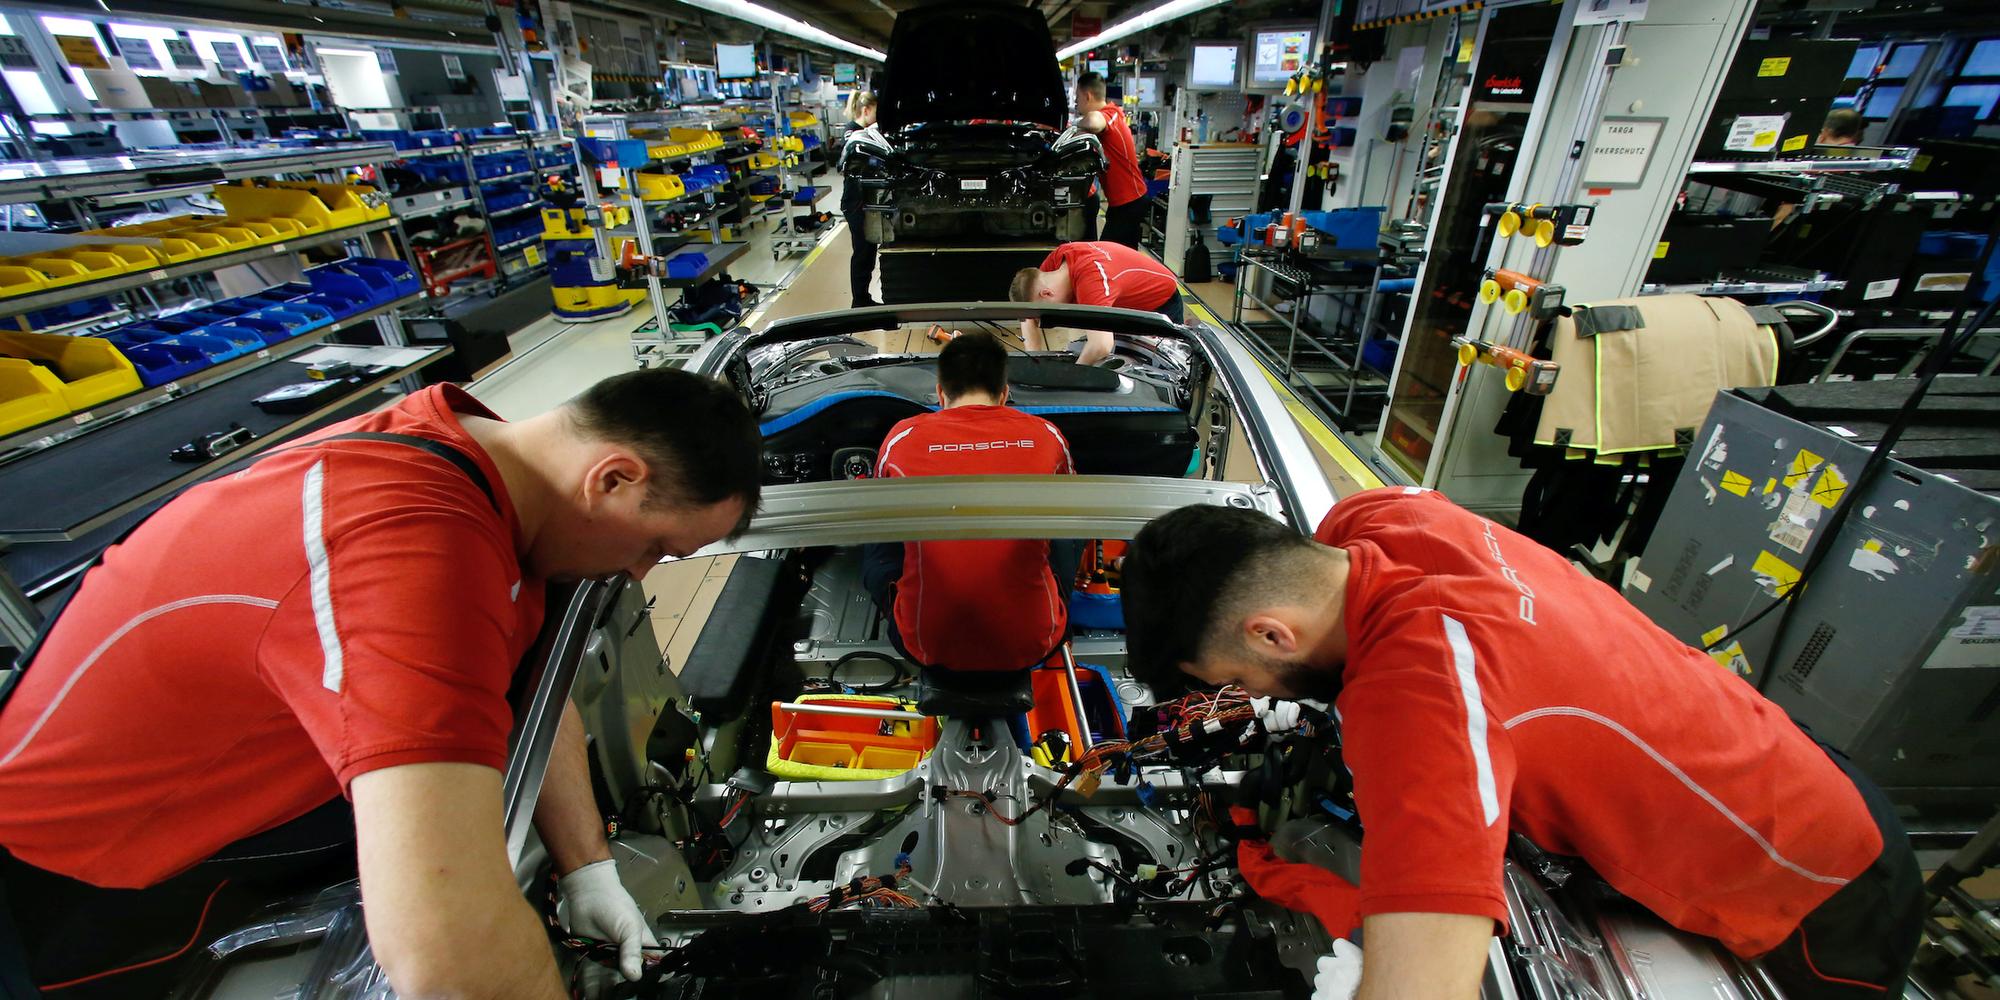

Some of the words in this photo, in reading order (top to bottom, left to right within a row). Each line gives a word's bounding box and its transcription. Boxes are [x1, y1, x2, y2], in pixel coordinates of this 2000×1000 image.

[1608, 126, 1633, 134] TARGA
[1594, 147, 1646, 155] RKERSCHUTZ
[928, 440, 1035, 453] PORSCHE
[1479, 515, 1537, 626] PORSCH
